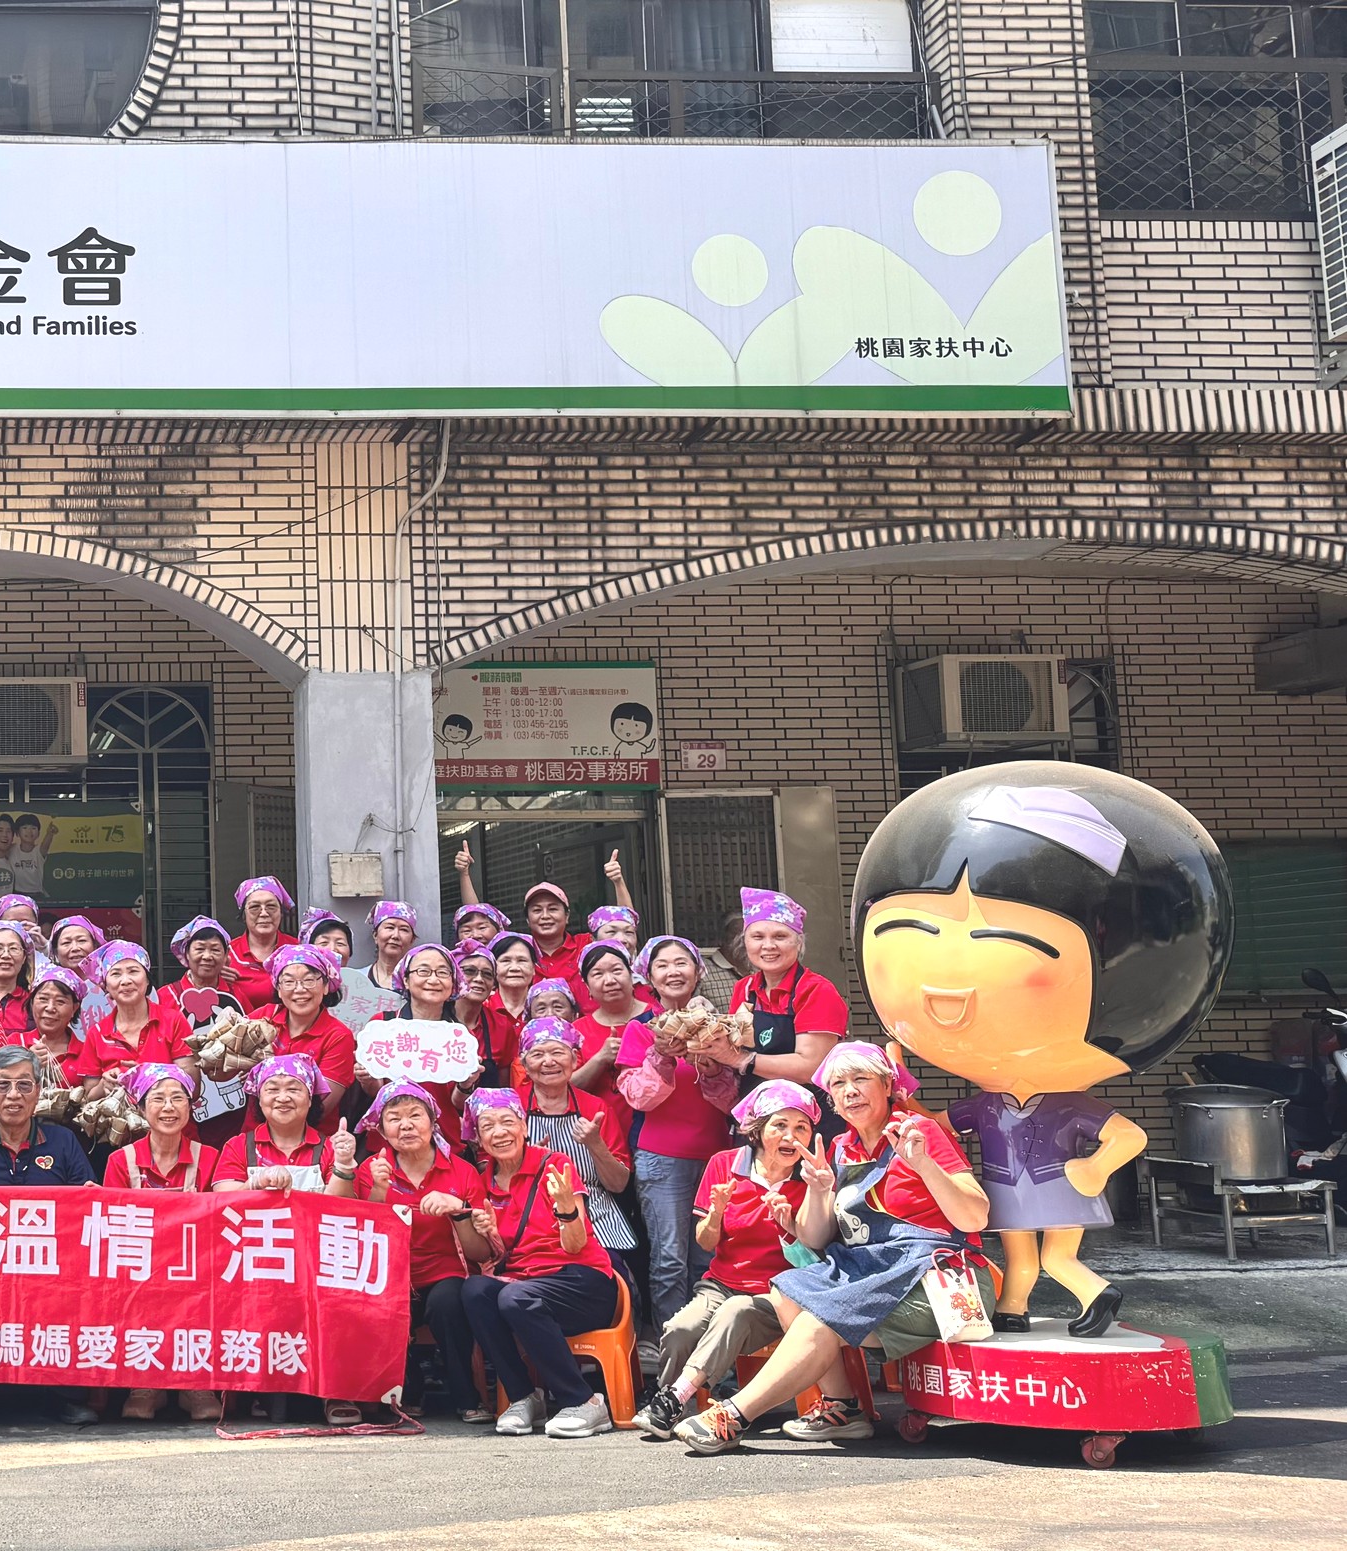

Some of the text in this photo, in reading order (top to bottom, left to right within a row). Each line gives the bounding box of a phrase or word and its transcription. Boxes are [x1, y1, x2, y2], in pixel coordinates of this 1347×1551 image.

[32, 315, 137, 336] Families
[854, 336, 1013, 358] 桃園家扶中心
[570, 746, 611, 756] T.F.C.F.
[697, 753, 717, 768] 29
[524, 761, 649, 782] 桃園分事務所
[365, 1031, 468, 1073] 感謝有您
[907, 1361, 1088, 1410] 桃園家扶中心
